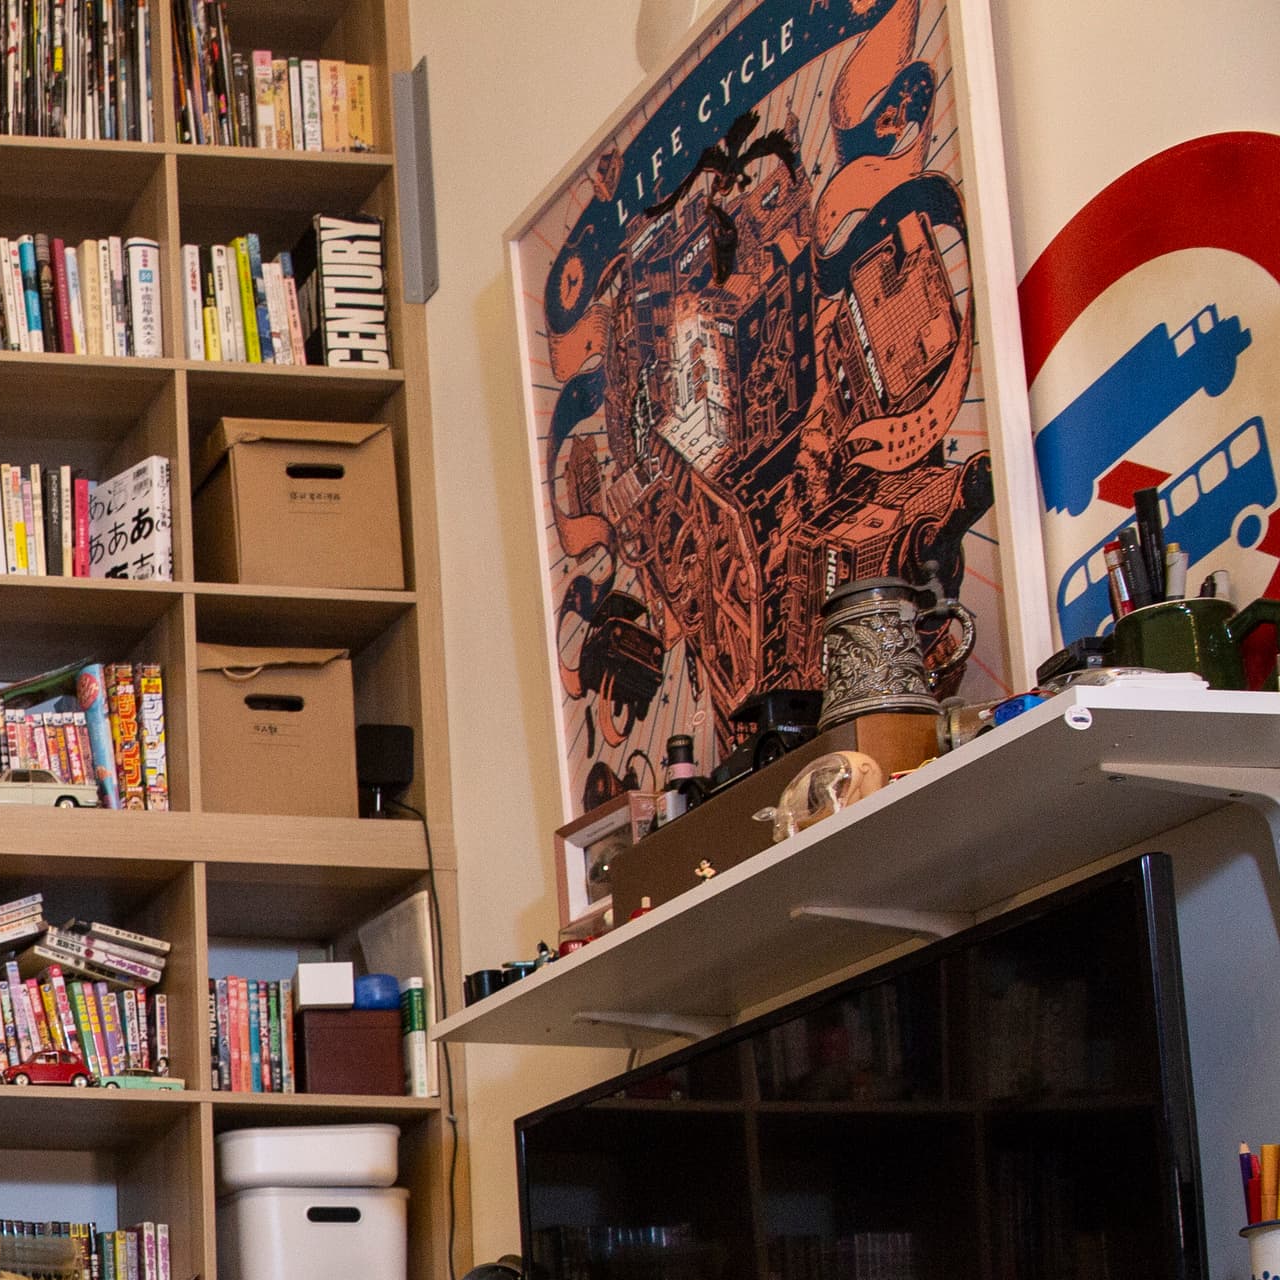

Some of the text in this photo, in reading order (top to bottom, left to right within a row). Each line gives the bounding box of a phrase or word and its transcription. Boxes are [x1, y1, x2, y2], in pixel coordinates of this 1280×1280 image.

[615, 18, 796, 227] LIFE CYCLE
[319, 216, 390, 369] CENTURY
[679, 235, 710, 271] HOTEL
[848, 292, 884, 398] PRIMARY SCHOOL
